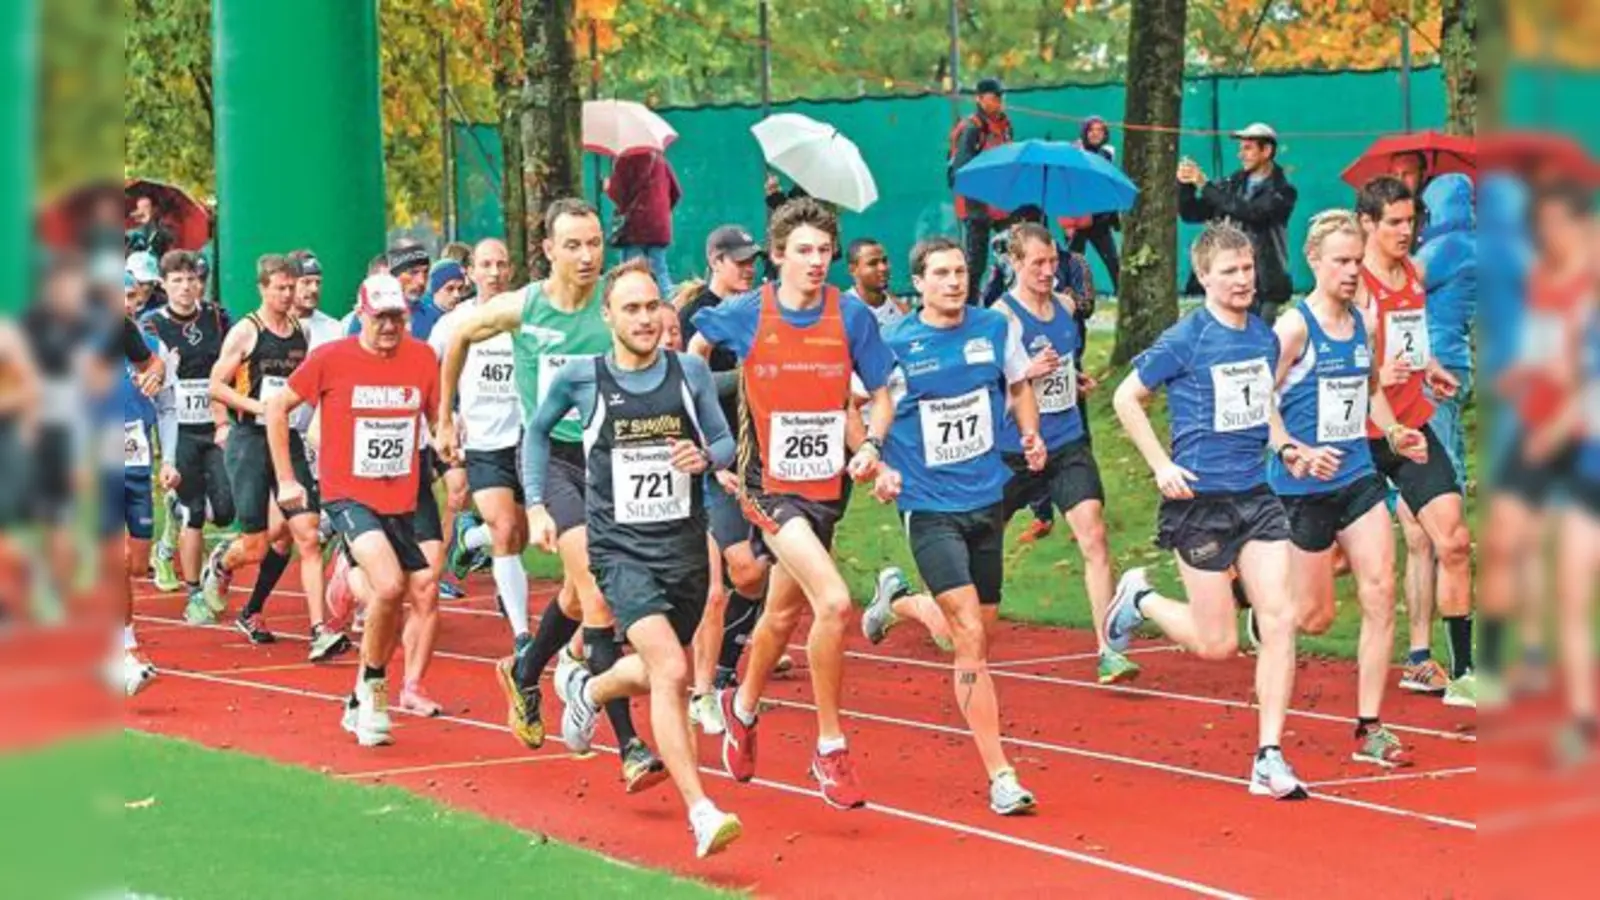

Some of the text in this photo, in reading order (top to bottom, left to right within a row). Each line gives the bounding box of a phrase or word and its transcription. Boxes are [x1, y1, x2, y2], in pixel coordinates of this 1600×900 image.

[1404, 332, 1414, 352] 2
[481, 364, 514, 381] 467
[1043, 375, 1069, 395] 251
[1242, 384, 1250, 406] 1
[1344, 400, 1354, 420] 7
[781, 415, 836, 427] Schweiger
[938, 415, 978, 444] 717
[368, 438, 404, 459] 525
[785, 434, 828, 459] 265
[630, 471, 673, 500] 721
